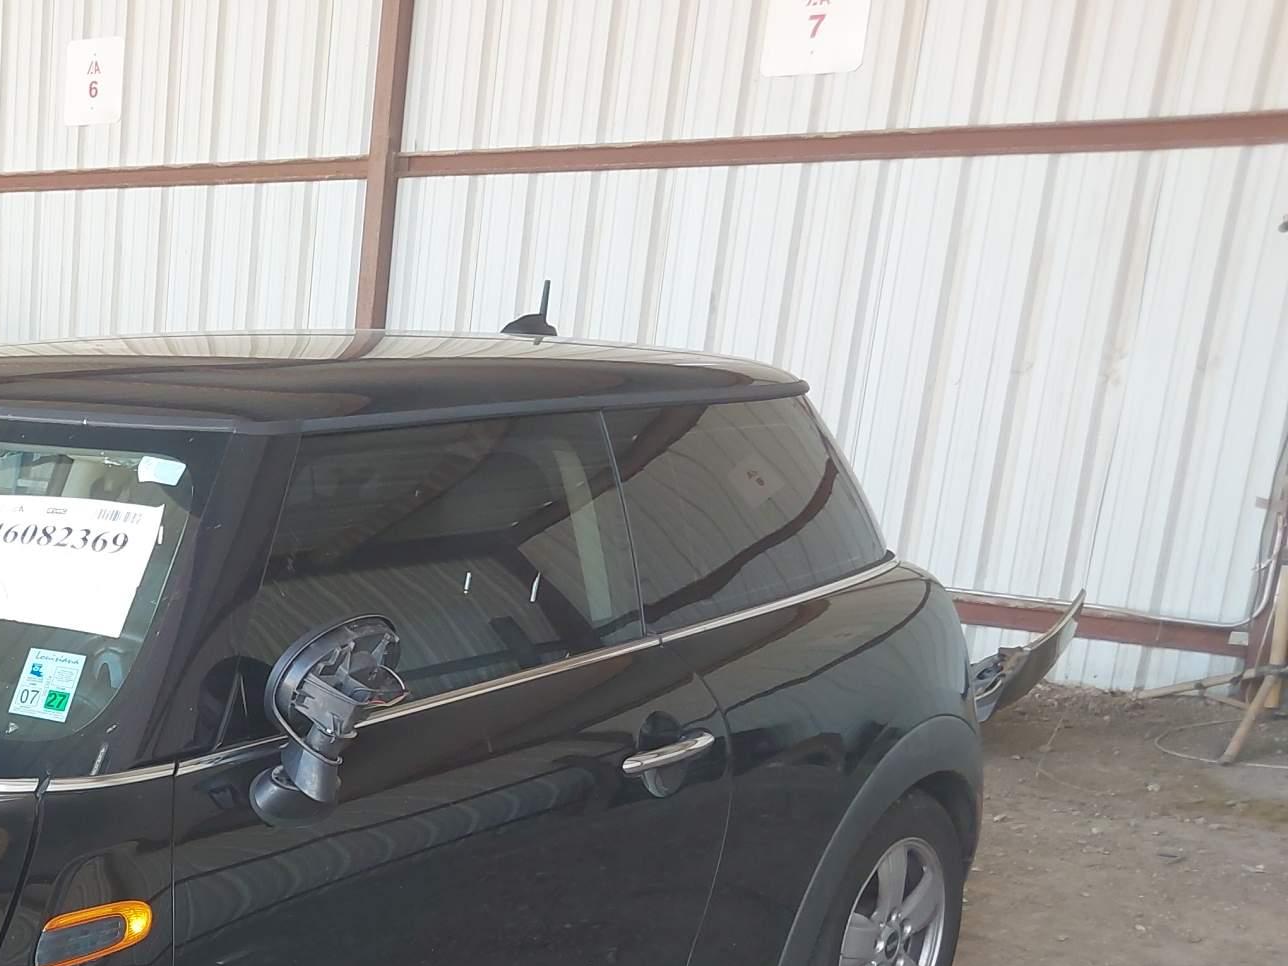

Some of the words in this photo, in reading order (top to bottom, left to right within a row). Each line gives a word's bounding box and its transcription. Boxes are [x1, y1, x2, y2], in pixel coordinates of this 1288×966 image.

[808, 14, 827, 39] 7
[88, 80, 99, 98] 6
[20, 688, 40, 704] 07
[46, 692, 67, 709] 27
